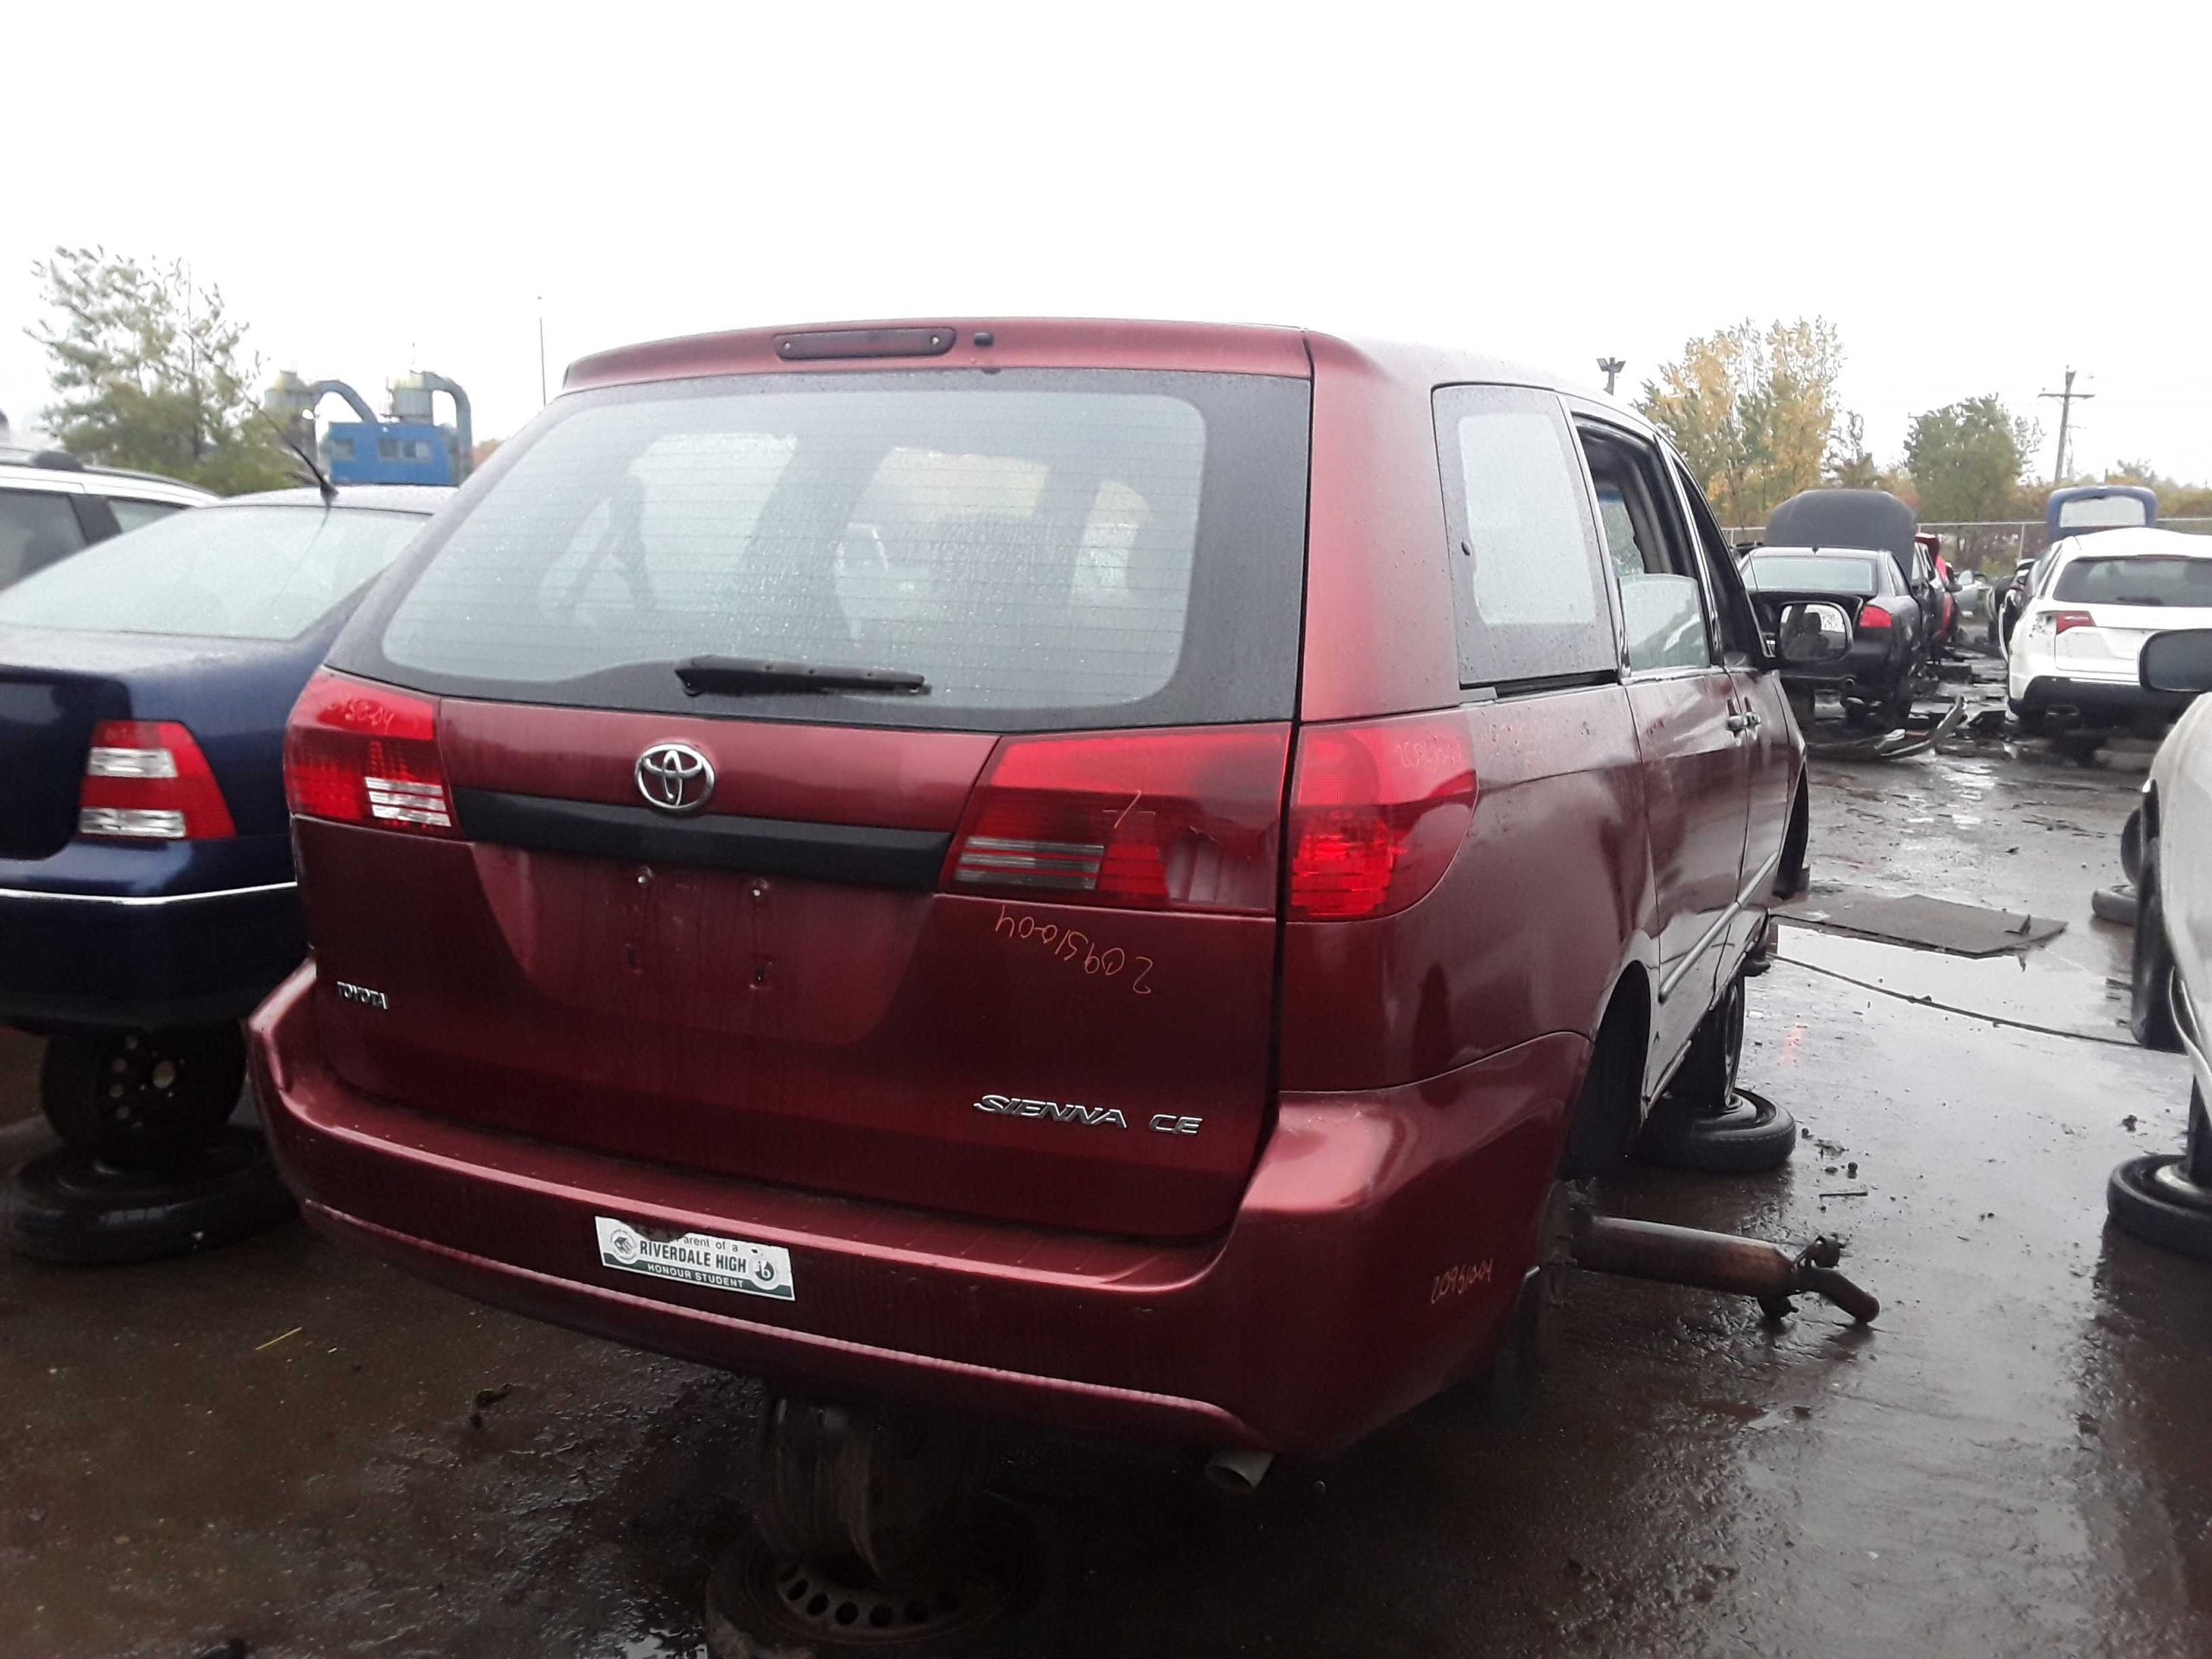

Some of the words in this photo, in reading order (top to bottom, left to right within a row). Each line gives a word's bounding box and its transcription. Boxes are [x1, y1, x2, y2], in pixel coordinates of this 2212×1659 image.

[336, 981, 388, 1010] TOYOTA
[973, 1094, 1128, 1128] SIENNA
[1148, 1114, 1204, 1135] CE
[639, 1240, 711, 1268] RIVERDALE
[715, 1254, 747, 1274] HIGH
[715, 1241, 726, 1250] of
[647, 1263, 692, 1279] HONOUR
[695, 1272, 744, 1288] STUDENT
